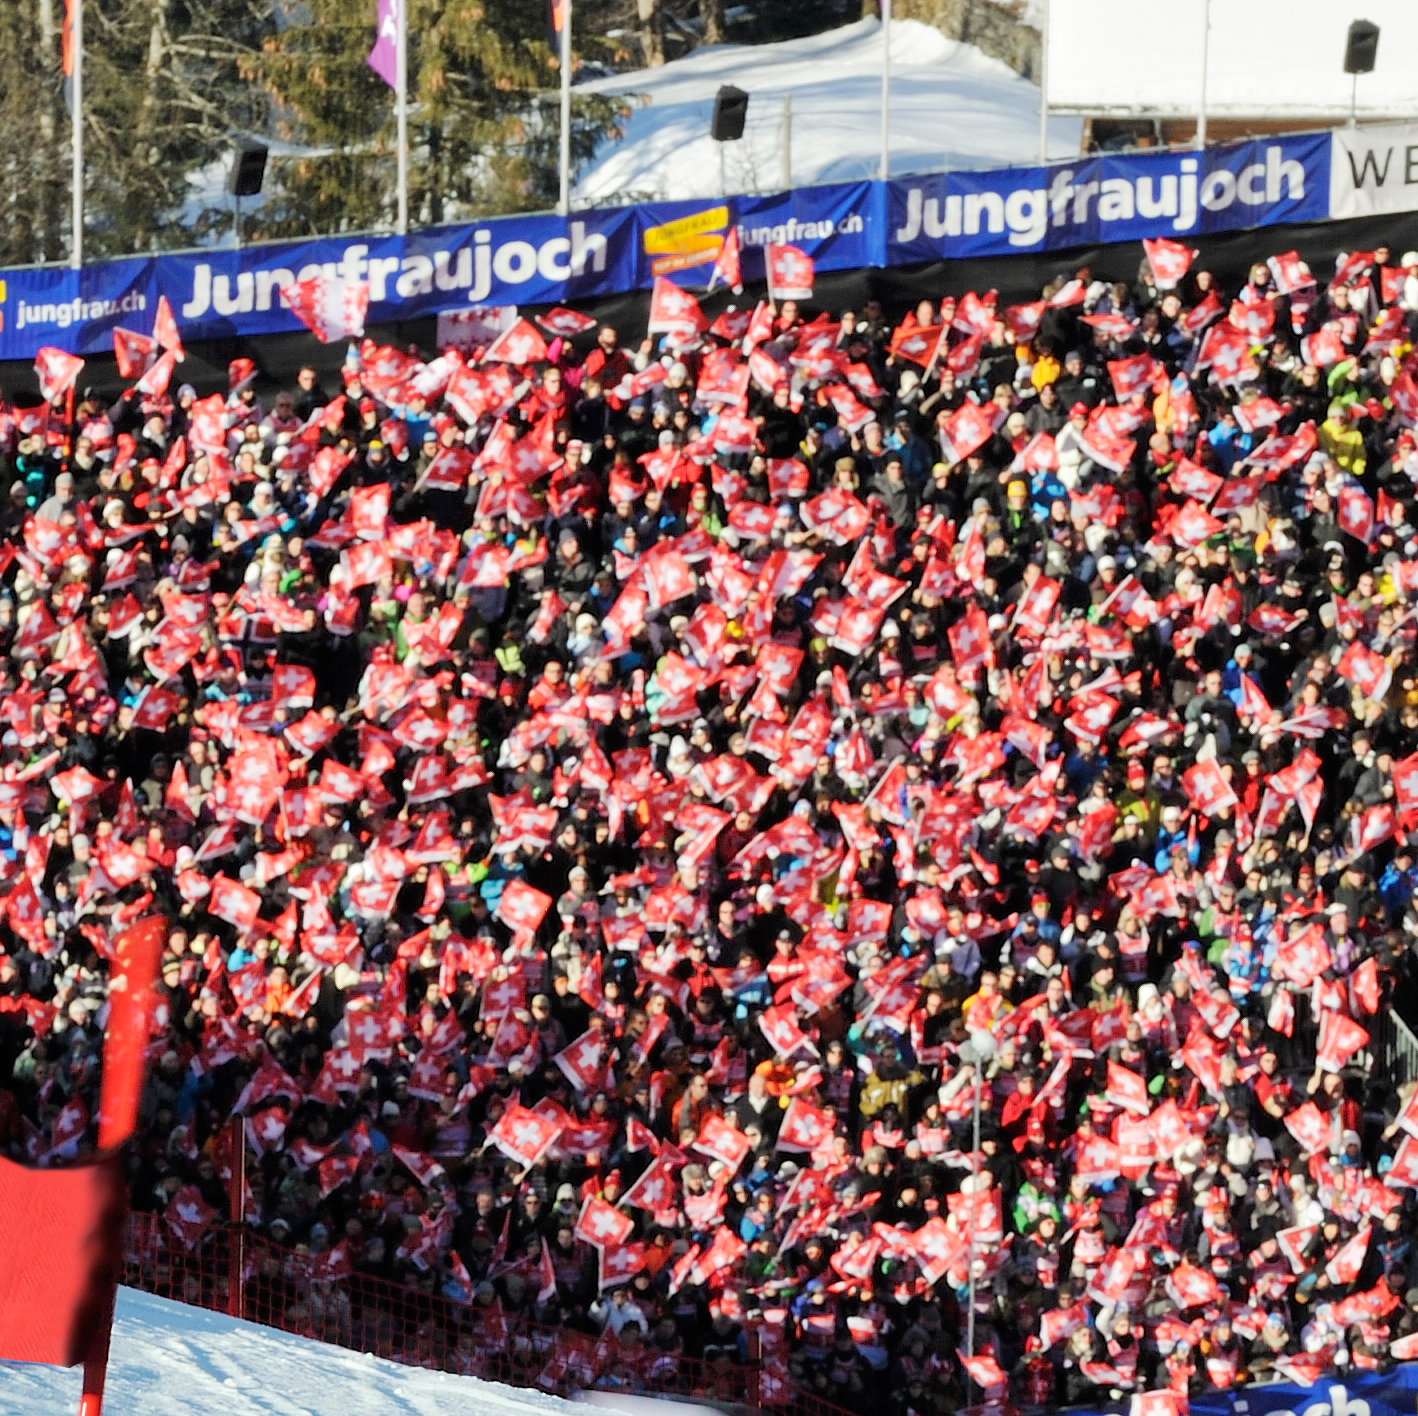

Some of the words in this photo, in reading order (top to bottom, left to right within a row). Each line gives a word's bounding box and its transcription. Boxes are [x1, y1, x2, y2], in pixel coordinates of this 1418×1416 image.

[896, 145, 1306, 247] Jungfraujoch
[737, 213, 864, 251] jungfrau.ch
[15, 289, 147, 330] jungfrau.ch
